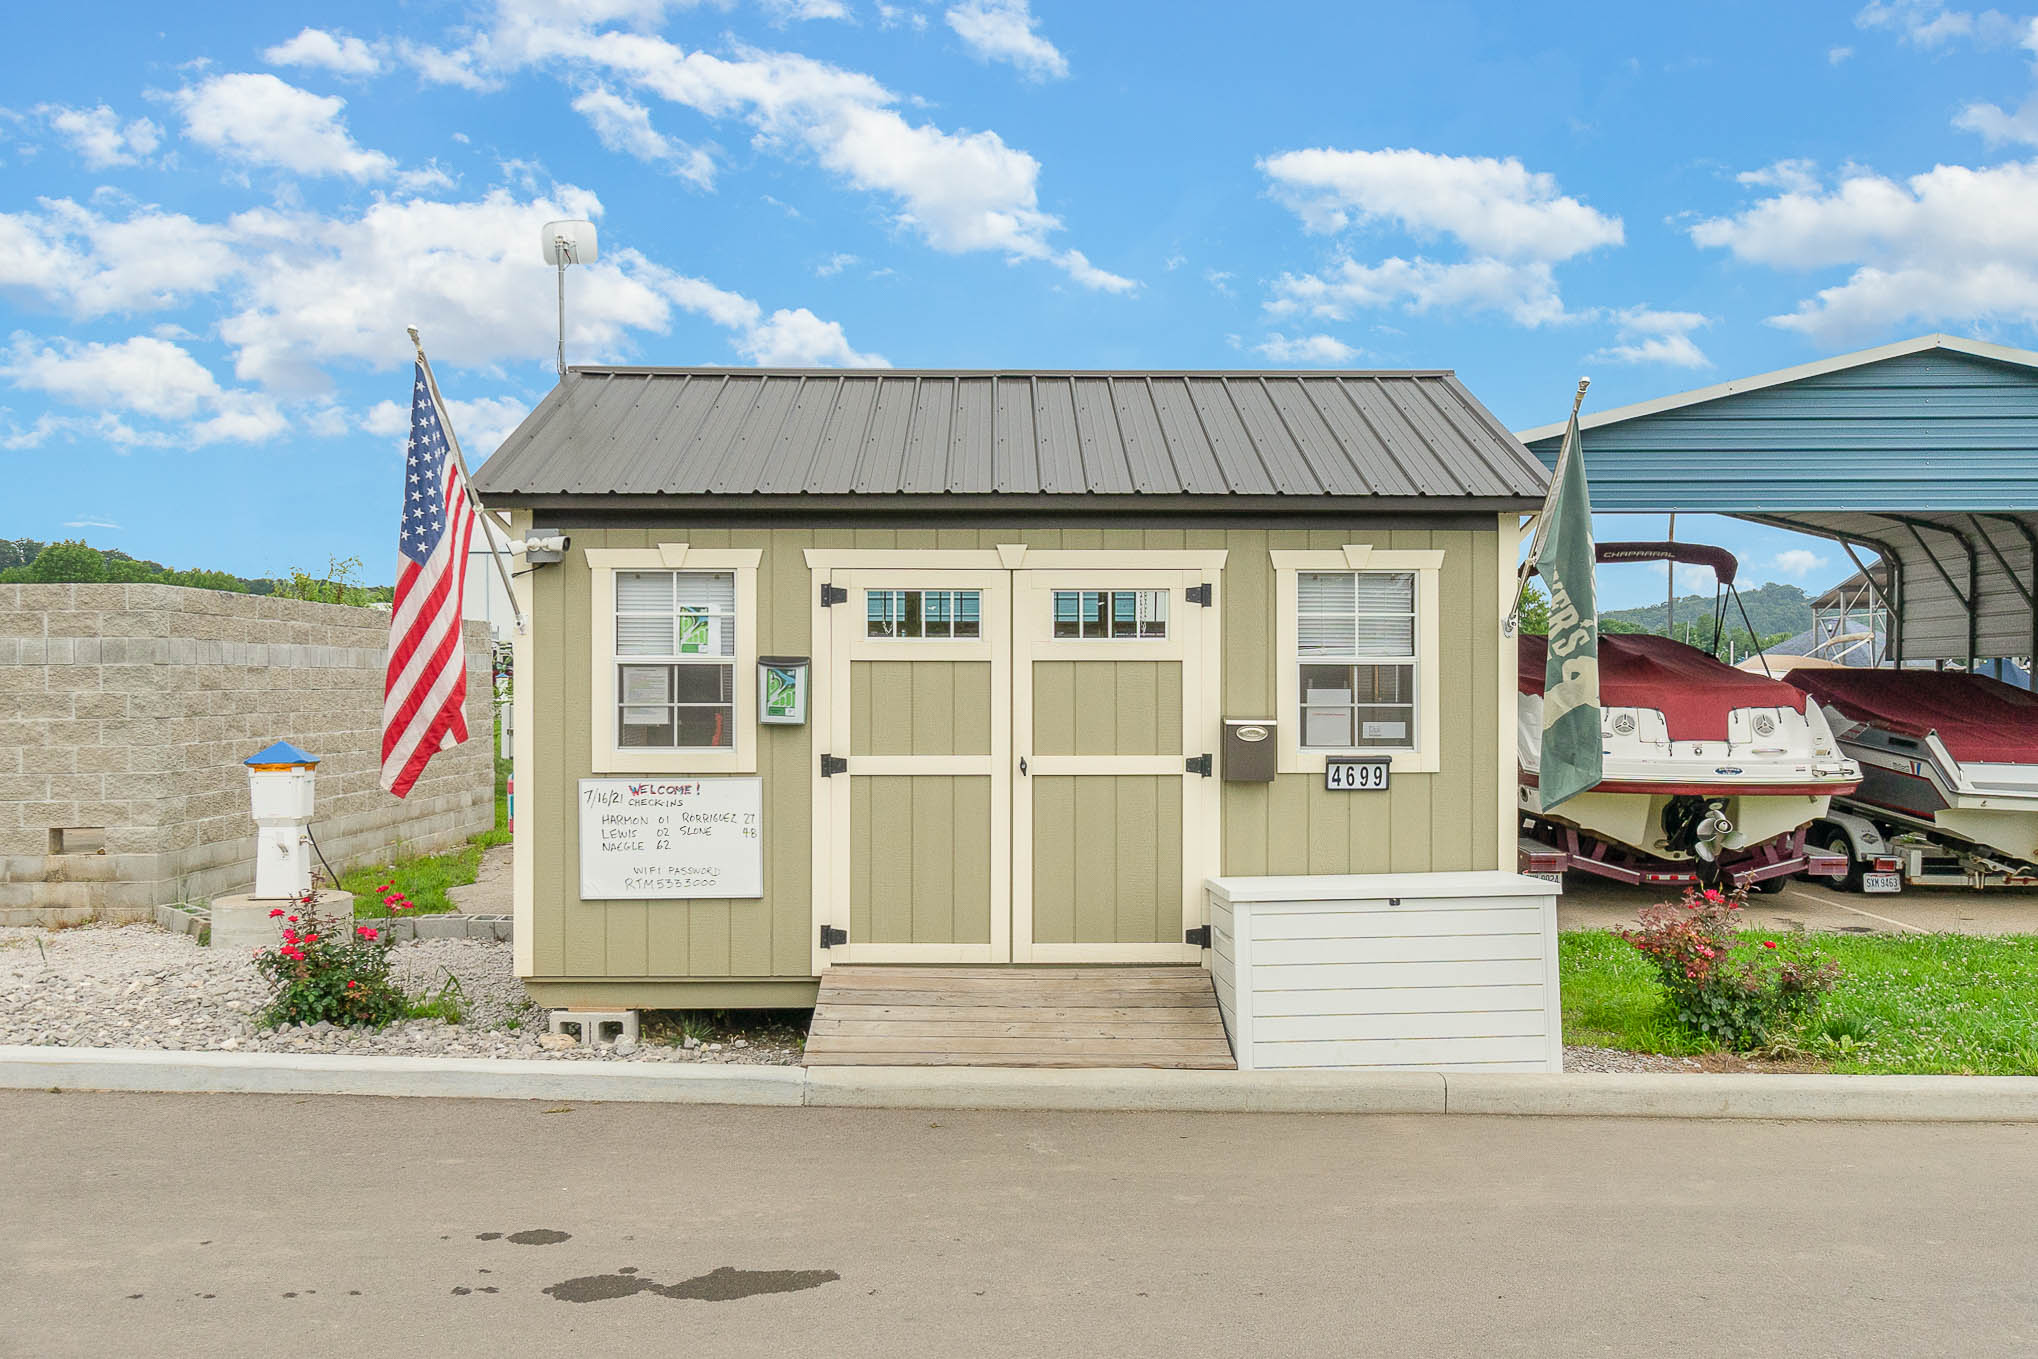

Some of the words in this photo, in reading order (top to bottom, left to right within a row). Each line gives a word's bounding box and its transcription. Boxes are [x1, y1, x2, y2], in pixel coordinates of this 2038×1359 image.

[1331, 765, 1383, 787] 4699
[584, 787, 623, 808] 7/16/21
[602, 814, 649, 825] HARMON
[658, 816, 669, 824] 01
[601, 828, 638, 839] LEWIS
[656, 827, 670, 838] 02
[679, 825, 712, 837] SLONE
[742, 826, 758, 839] 48
[656, 839, 671, 850] 62
[633, 866, 661, 875] WIFI
[668, 866, 721, 877] PASSWORD
